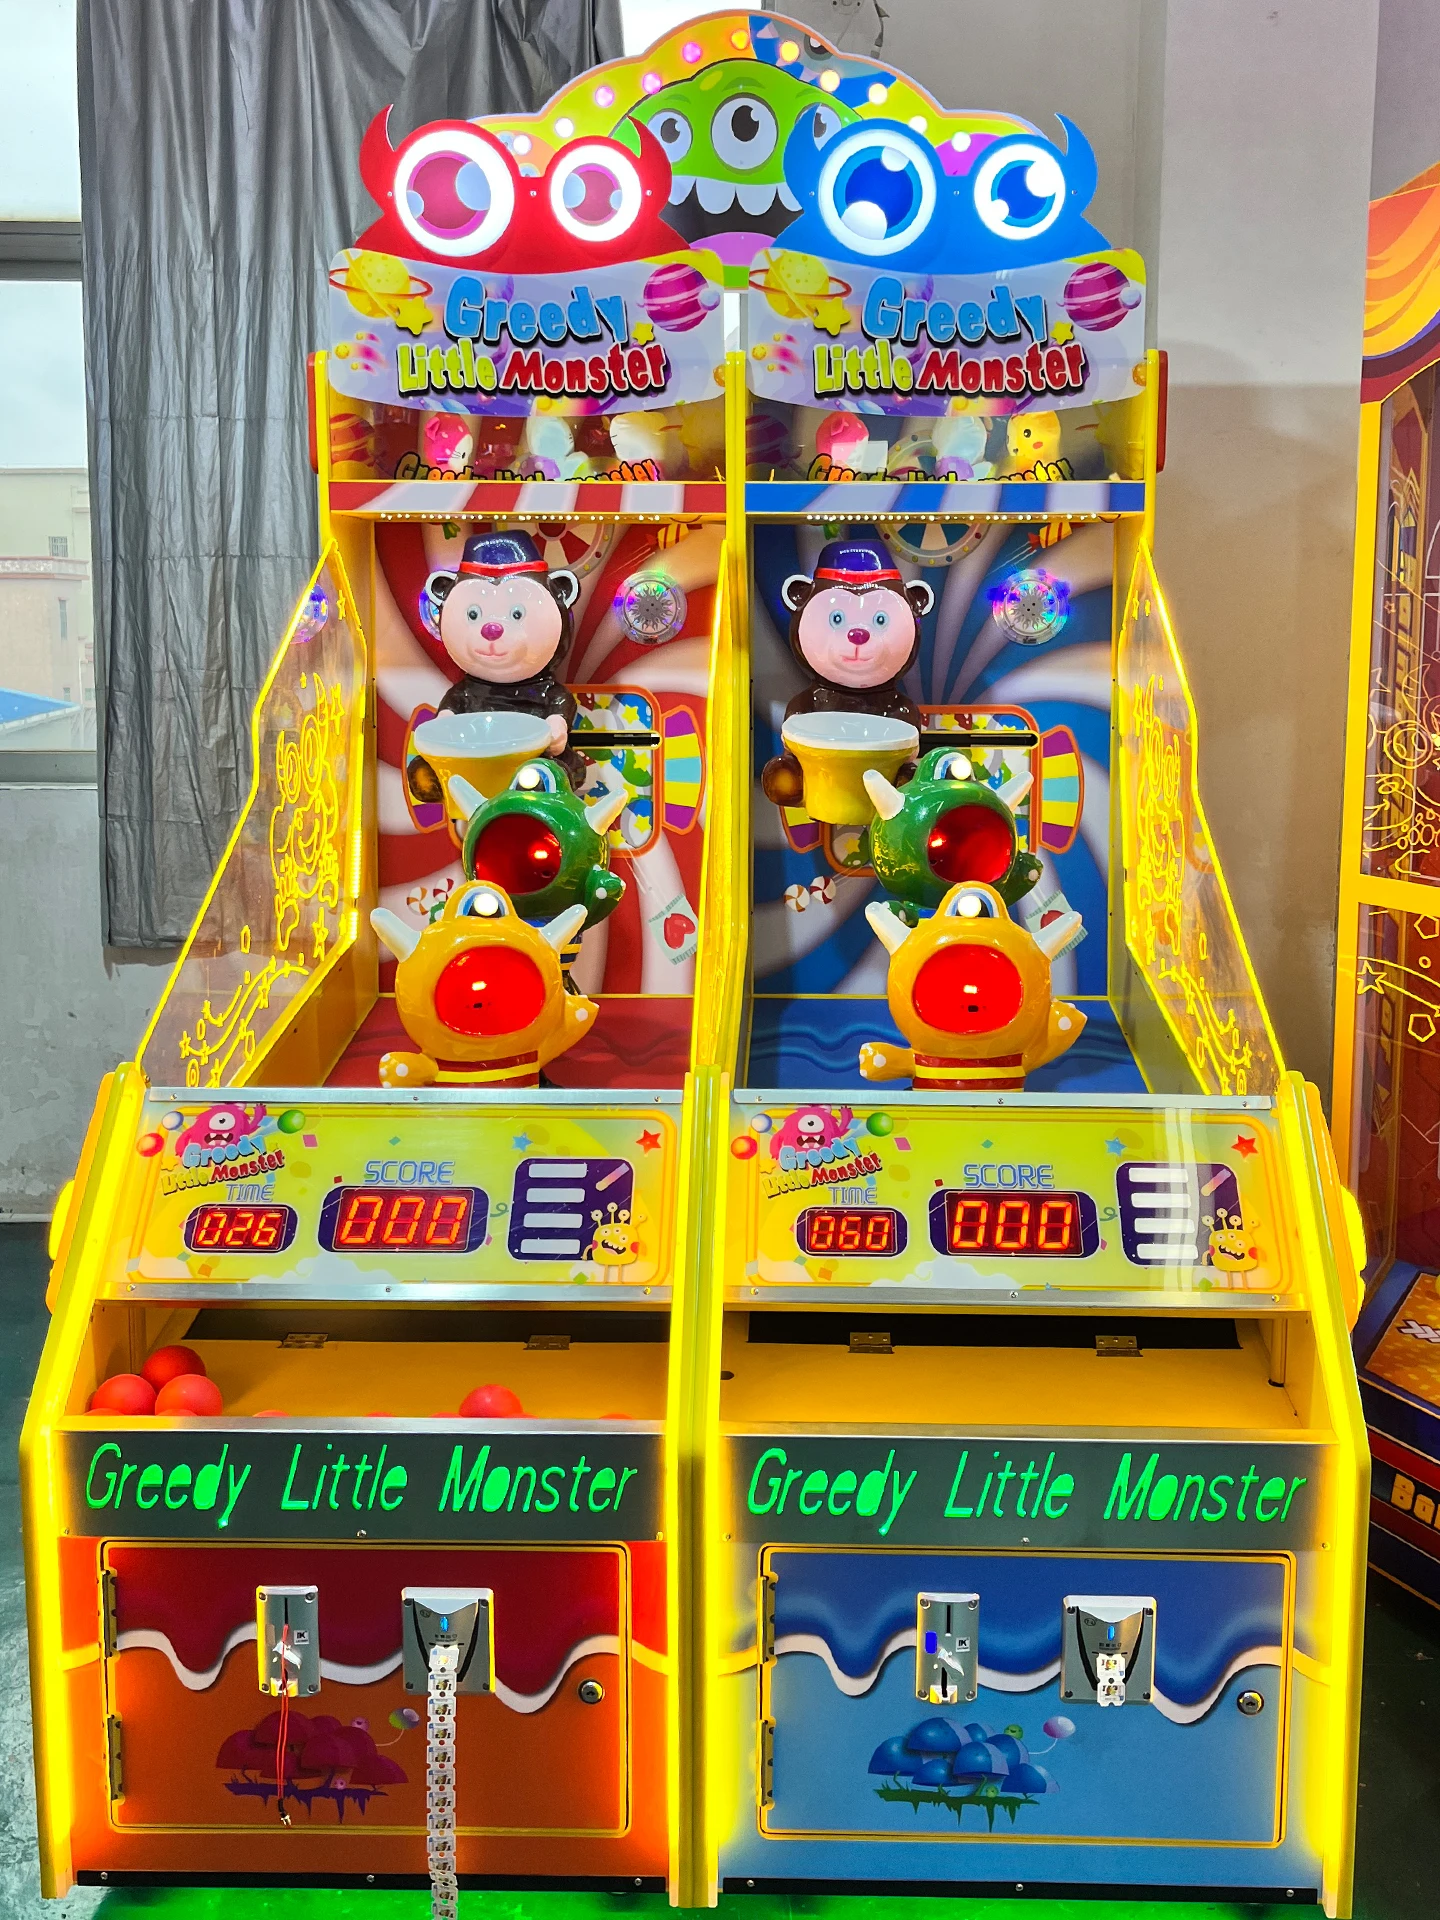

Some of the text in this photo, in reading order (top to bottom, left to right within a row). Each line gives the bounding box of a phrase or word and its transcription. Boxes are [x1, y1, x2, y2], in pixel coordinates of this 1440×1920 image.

[443, 275, 629, 344] Greedy
[861, 275, 1048, 344] Greedy
[396, 337, 667, 393] Little Monster
[813, 337, 1086, 394] Little Monster
[182, 1134, 267, 1169] Greedy
[209, 1149, 285, 1184] Monster
[779, 1137, 861, 1172] Greedy
[811, 1151, 883, 1187] Monster
[364, 1159, 455, 1185] SCORE
[963, 1163, 1054, 1189] SCORE
[226, 1183, 274, 1203] TIME
[828, 1186, 877, 1206] TIME
[196, 1211, 284, 1247] 026
[339, 1195, 469, 1245] 000
[810, 1215, 891, 1251] 060
[952, 1200, 1073, 1248] 000
[85, 1442, 637, 1529] Greedy Little Monster
[747, 1447, 1307, 1537] Greedy Little Monster
